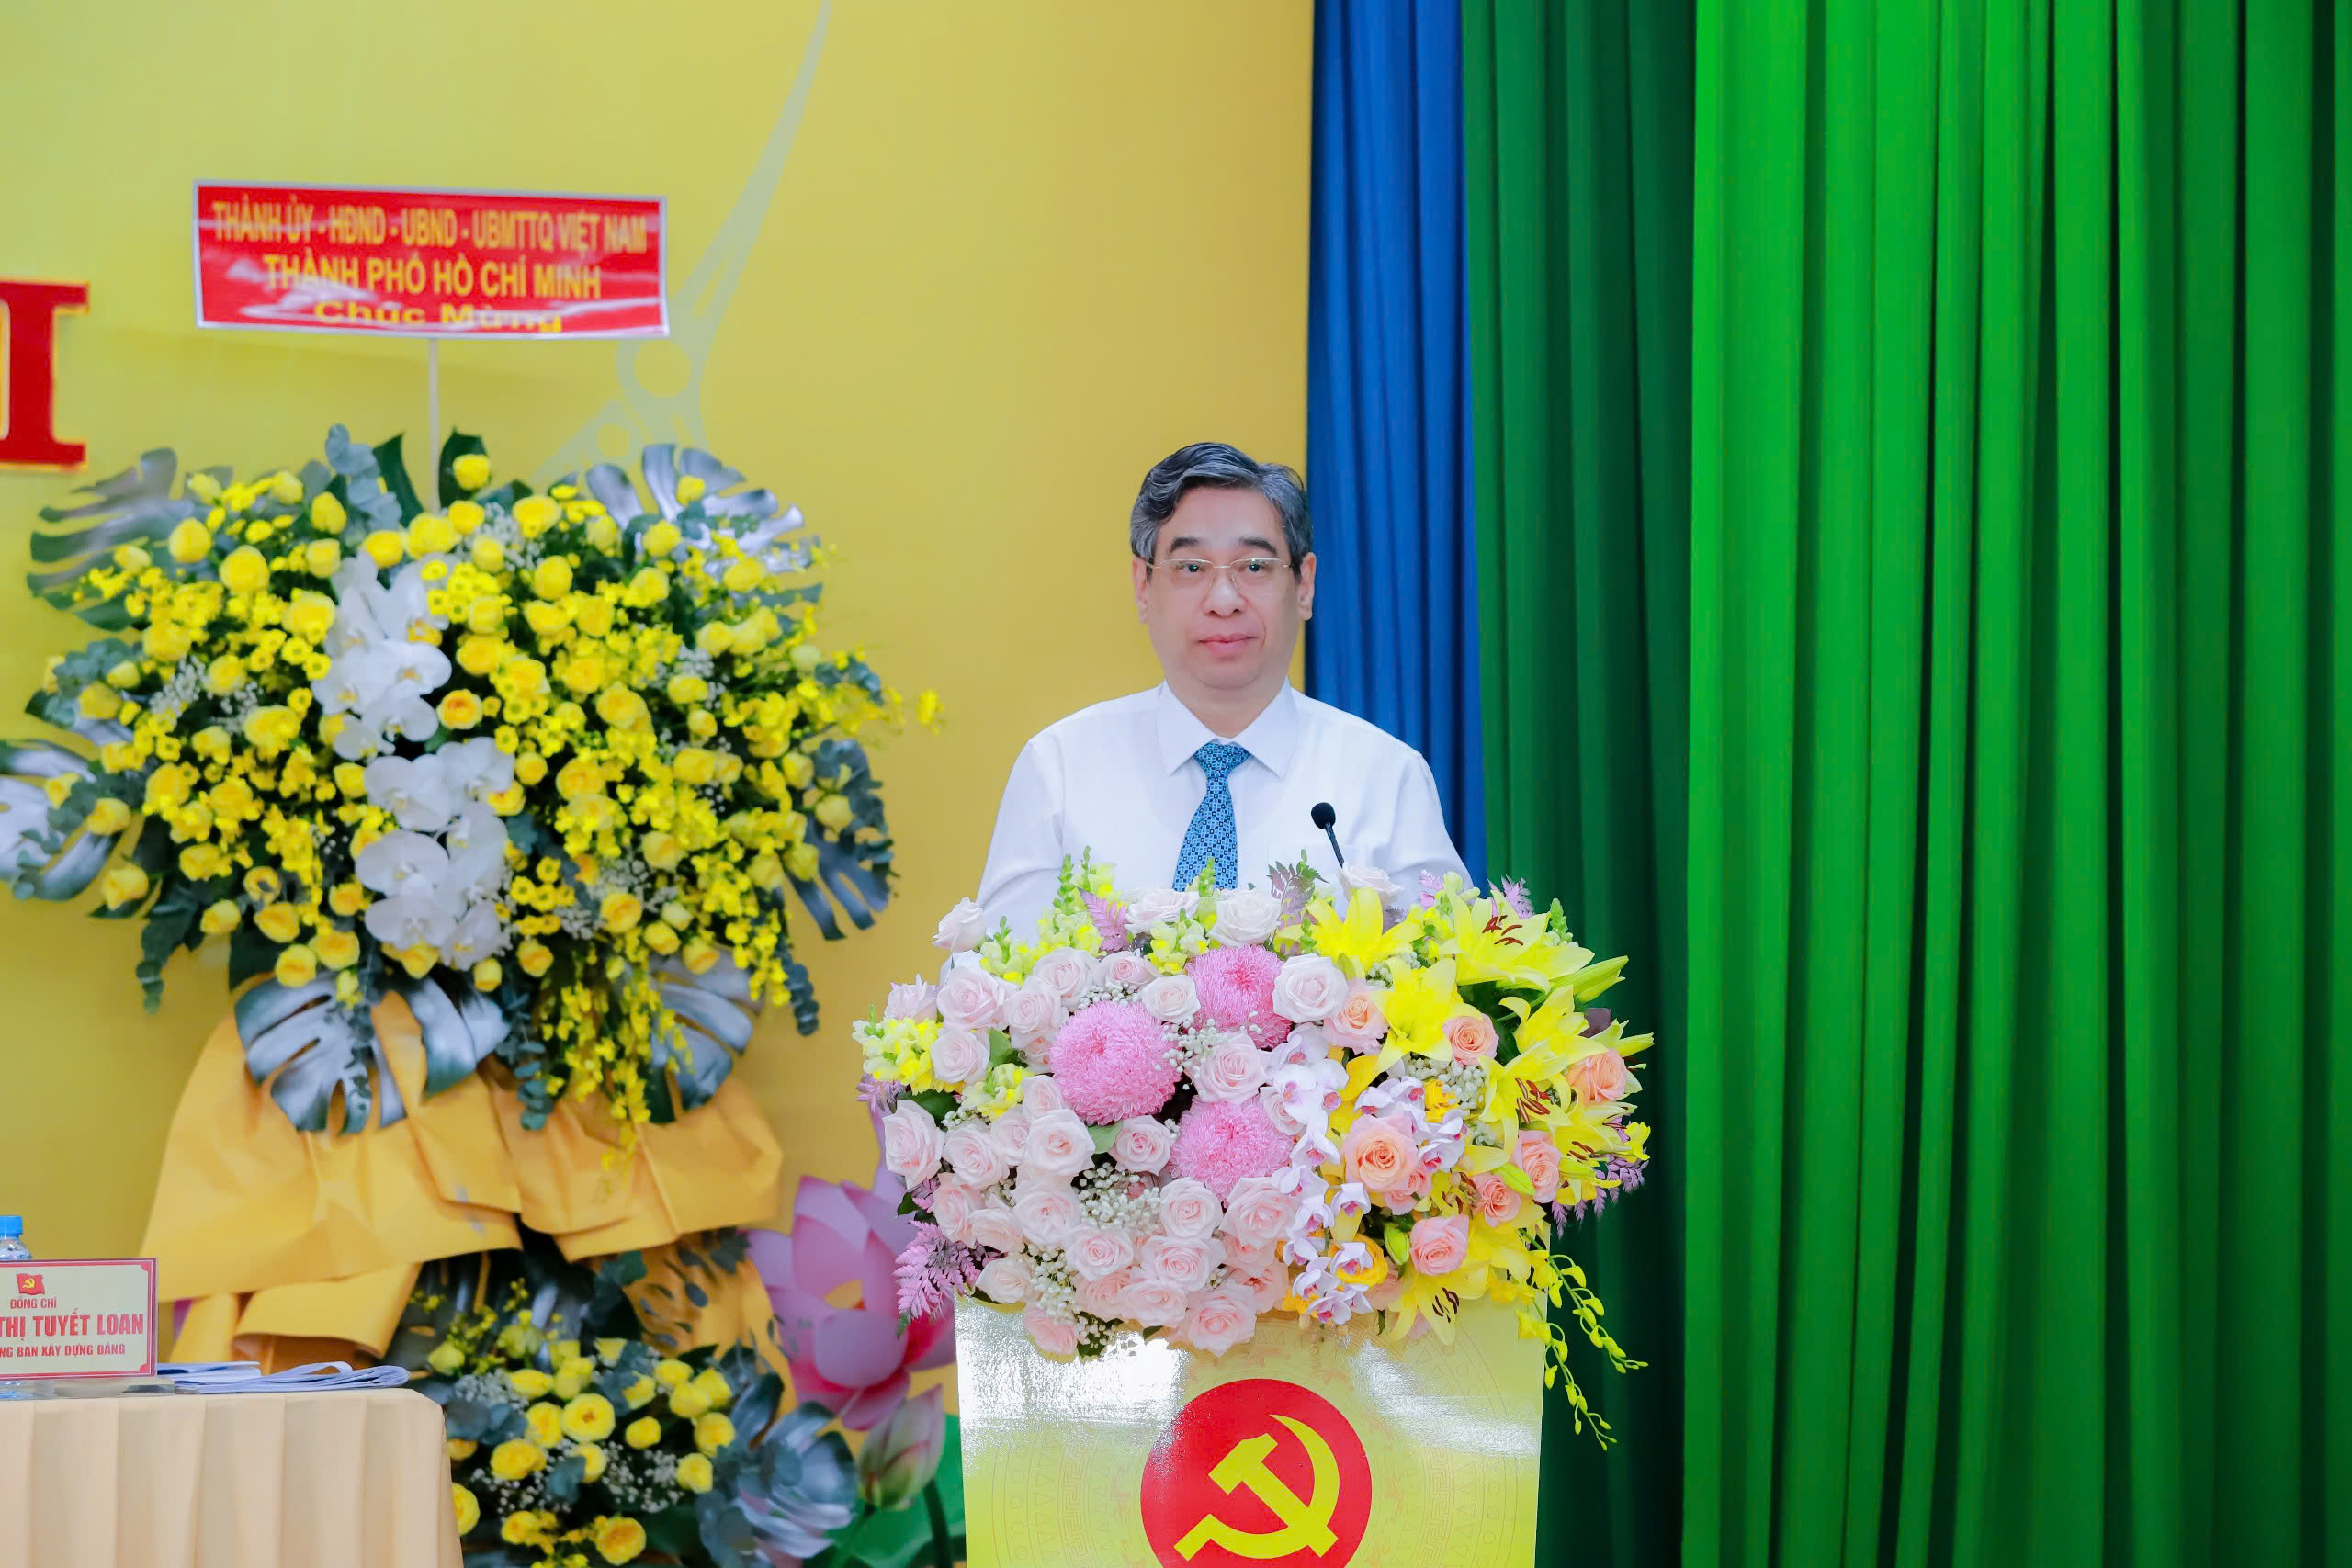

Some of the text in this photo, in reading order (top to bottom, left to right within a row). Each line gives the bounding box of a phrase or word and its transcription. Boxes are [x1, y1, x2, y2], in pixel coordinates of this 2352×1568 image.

[212, 193, 282, 243] THÀNH
[401, 208, 458, 250] UBND
[472, 210, 554, 251] UBMTTQ
[604, 215, 647, 254] NAM
[263, 247, 359, 290] THÀNH
[480, 254, 526, 298] CHÍ
[534, 263, 601, 299] MINH
[40, 1296, 57, 1308] CHÍ
[33, 1308, 90, 1337] TUYẾT
[96, 1314, 144, 1336] LOAN
[17, 1346, 39, 1357] BAN
